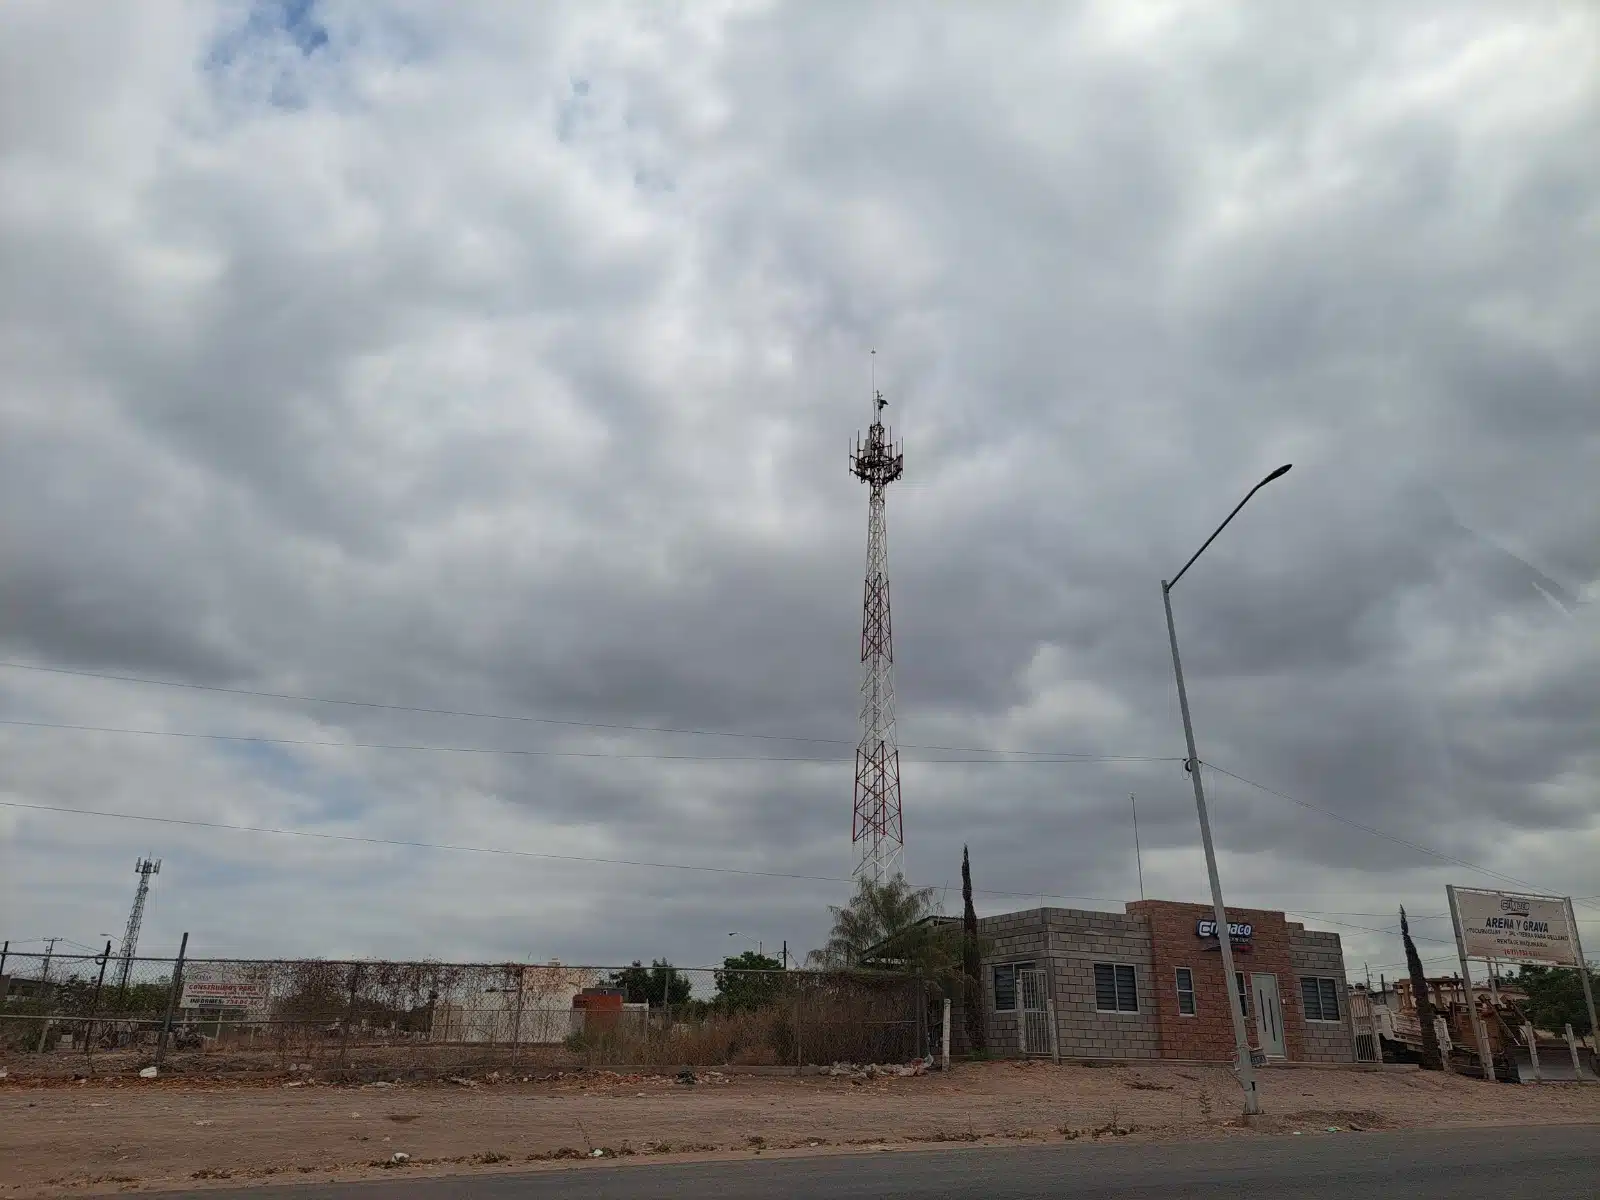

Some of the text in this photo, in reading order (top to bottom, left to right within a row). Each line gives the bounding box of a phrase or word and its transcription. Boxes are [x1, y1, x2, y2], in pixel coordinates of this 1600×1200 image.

[1485, 917, 1548, 933] ARENA Y GRAVA
